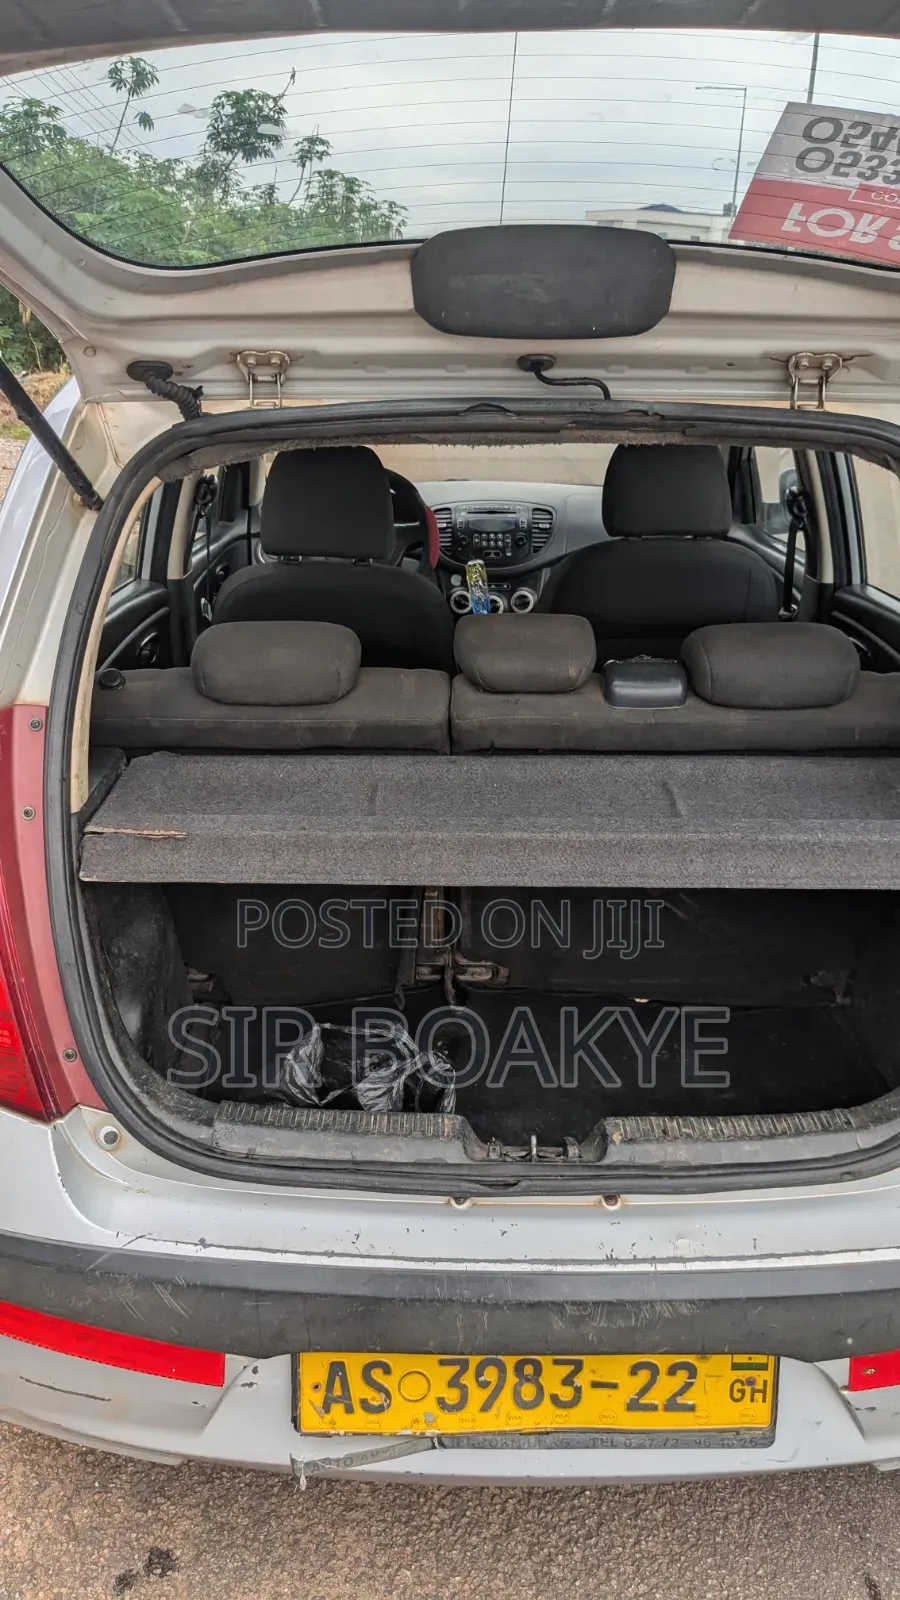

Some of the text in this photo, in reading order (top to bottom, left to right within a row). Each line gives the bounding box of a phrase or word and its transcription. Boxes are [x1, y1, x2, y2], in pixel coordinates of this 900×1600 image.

[321, 1356, 699, 1415] AS 3983-22
[728, 1379, 768, 1404] GH
